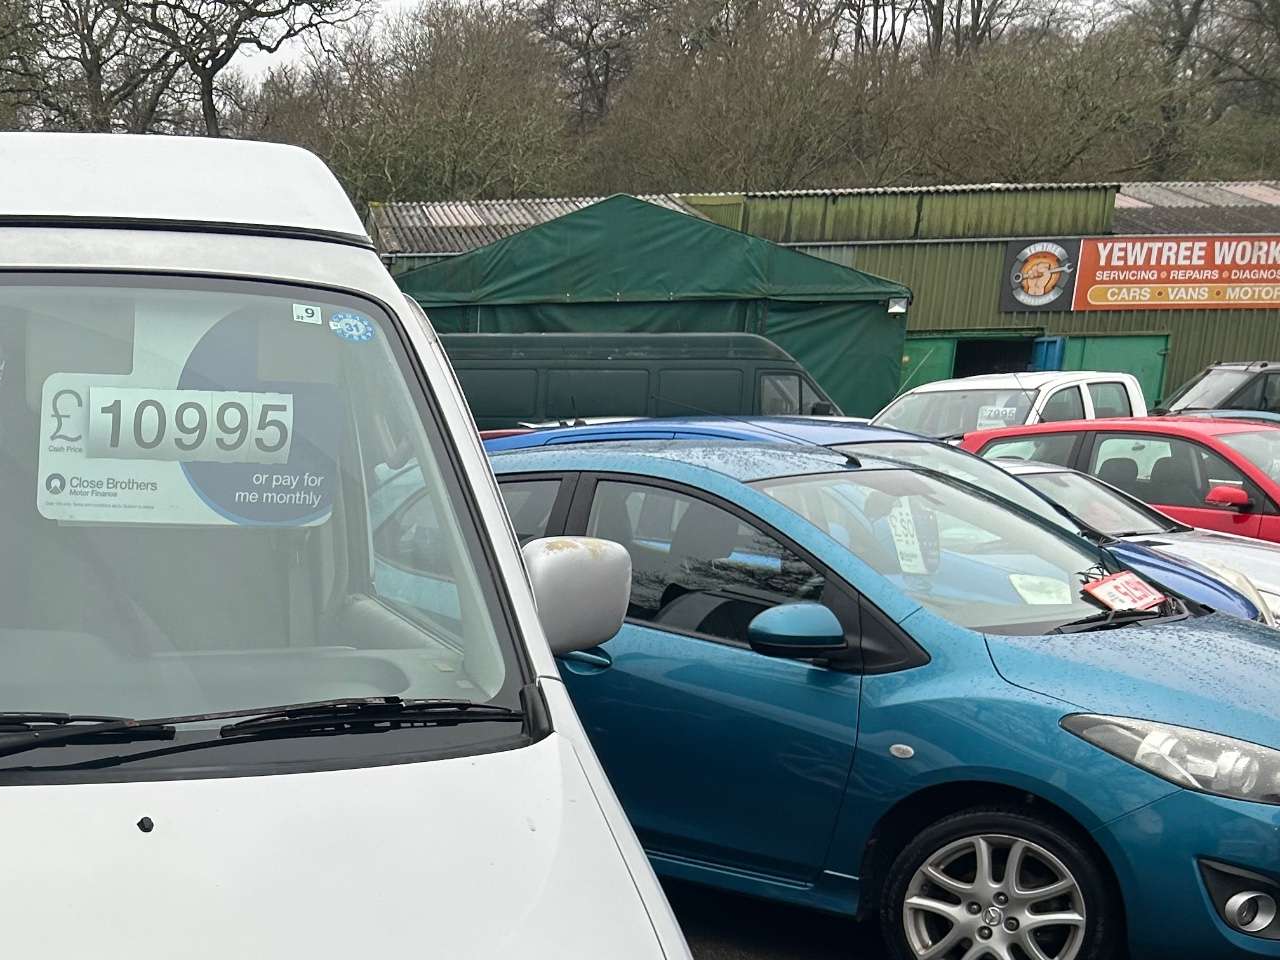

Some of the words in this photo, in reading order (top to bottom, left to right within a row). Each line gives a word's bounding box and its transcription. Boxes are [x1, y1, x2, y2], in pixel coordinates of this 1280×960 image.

[1096, 241, 1206, 266] YEWTREE
[1095, 270, 1157, 281] SERVICING
[1169, 269, 1219, 280] REPAIRS
[1107, 287, 1150, 300] CARS
[1168, 287, 1208, 300] VANS
[305, 307, 315, 318] 9
[100, 399, 289, 452] 10995
[70, 476, 104, 489] Close
[106, 477, 158, 491] Brothers
[252, 474, 270, 485] or
[272, 474, 300, 490] pay
[303, 472, 324, 487] for
[70, 489, 89, 497] Motor
[235, 491, 259, 503] me
[262, 491, 322, 507] monthly
